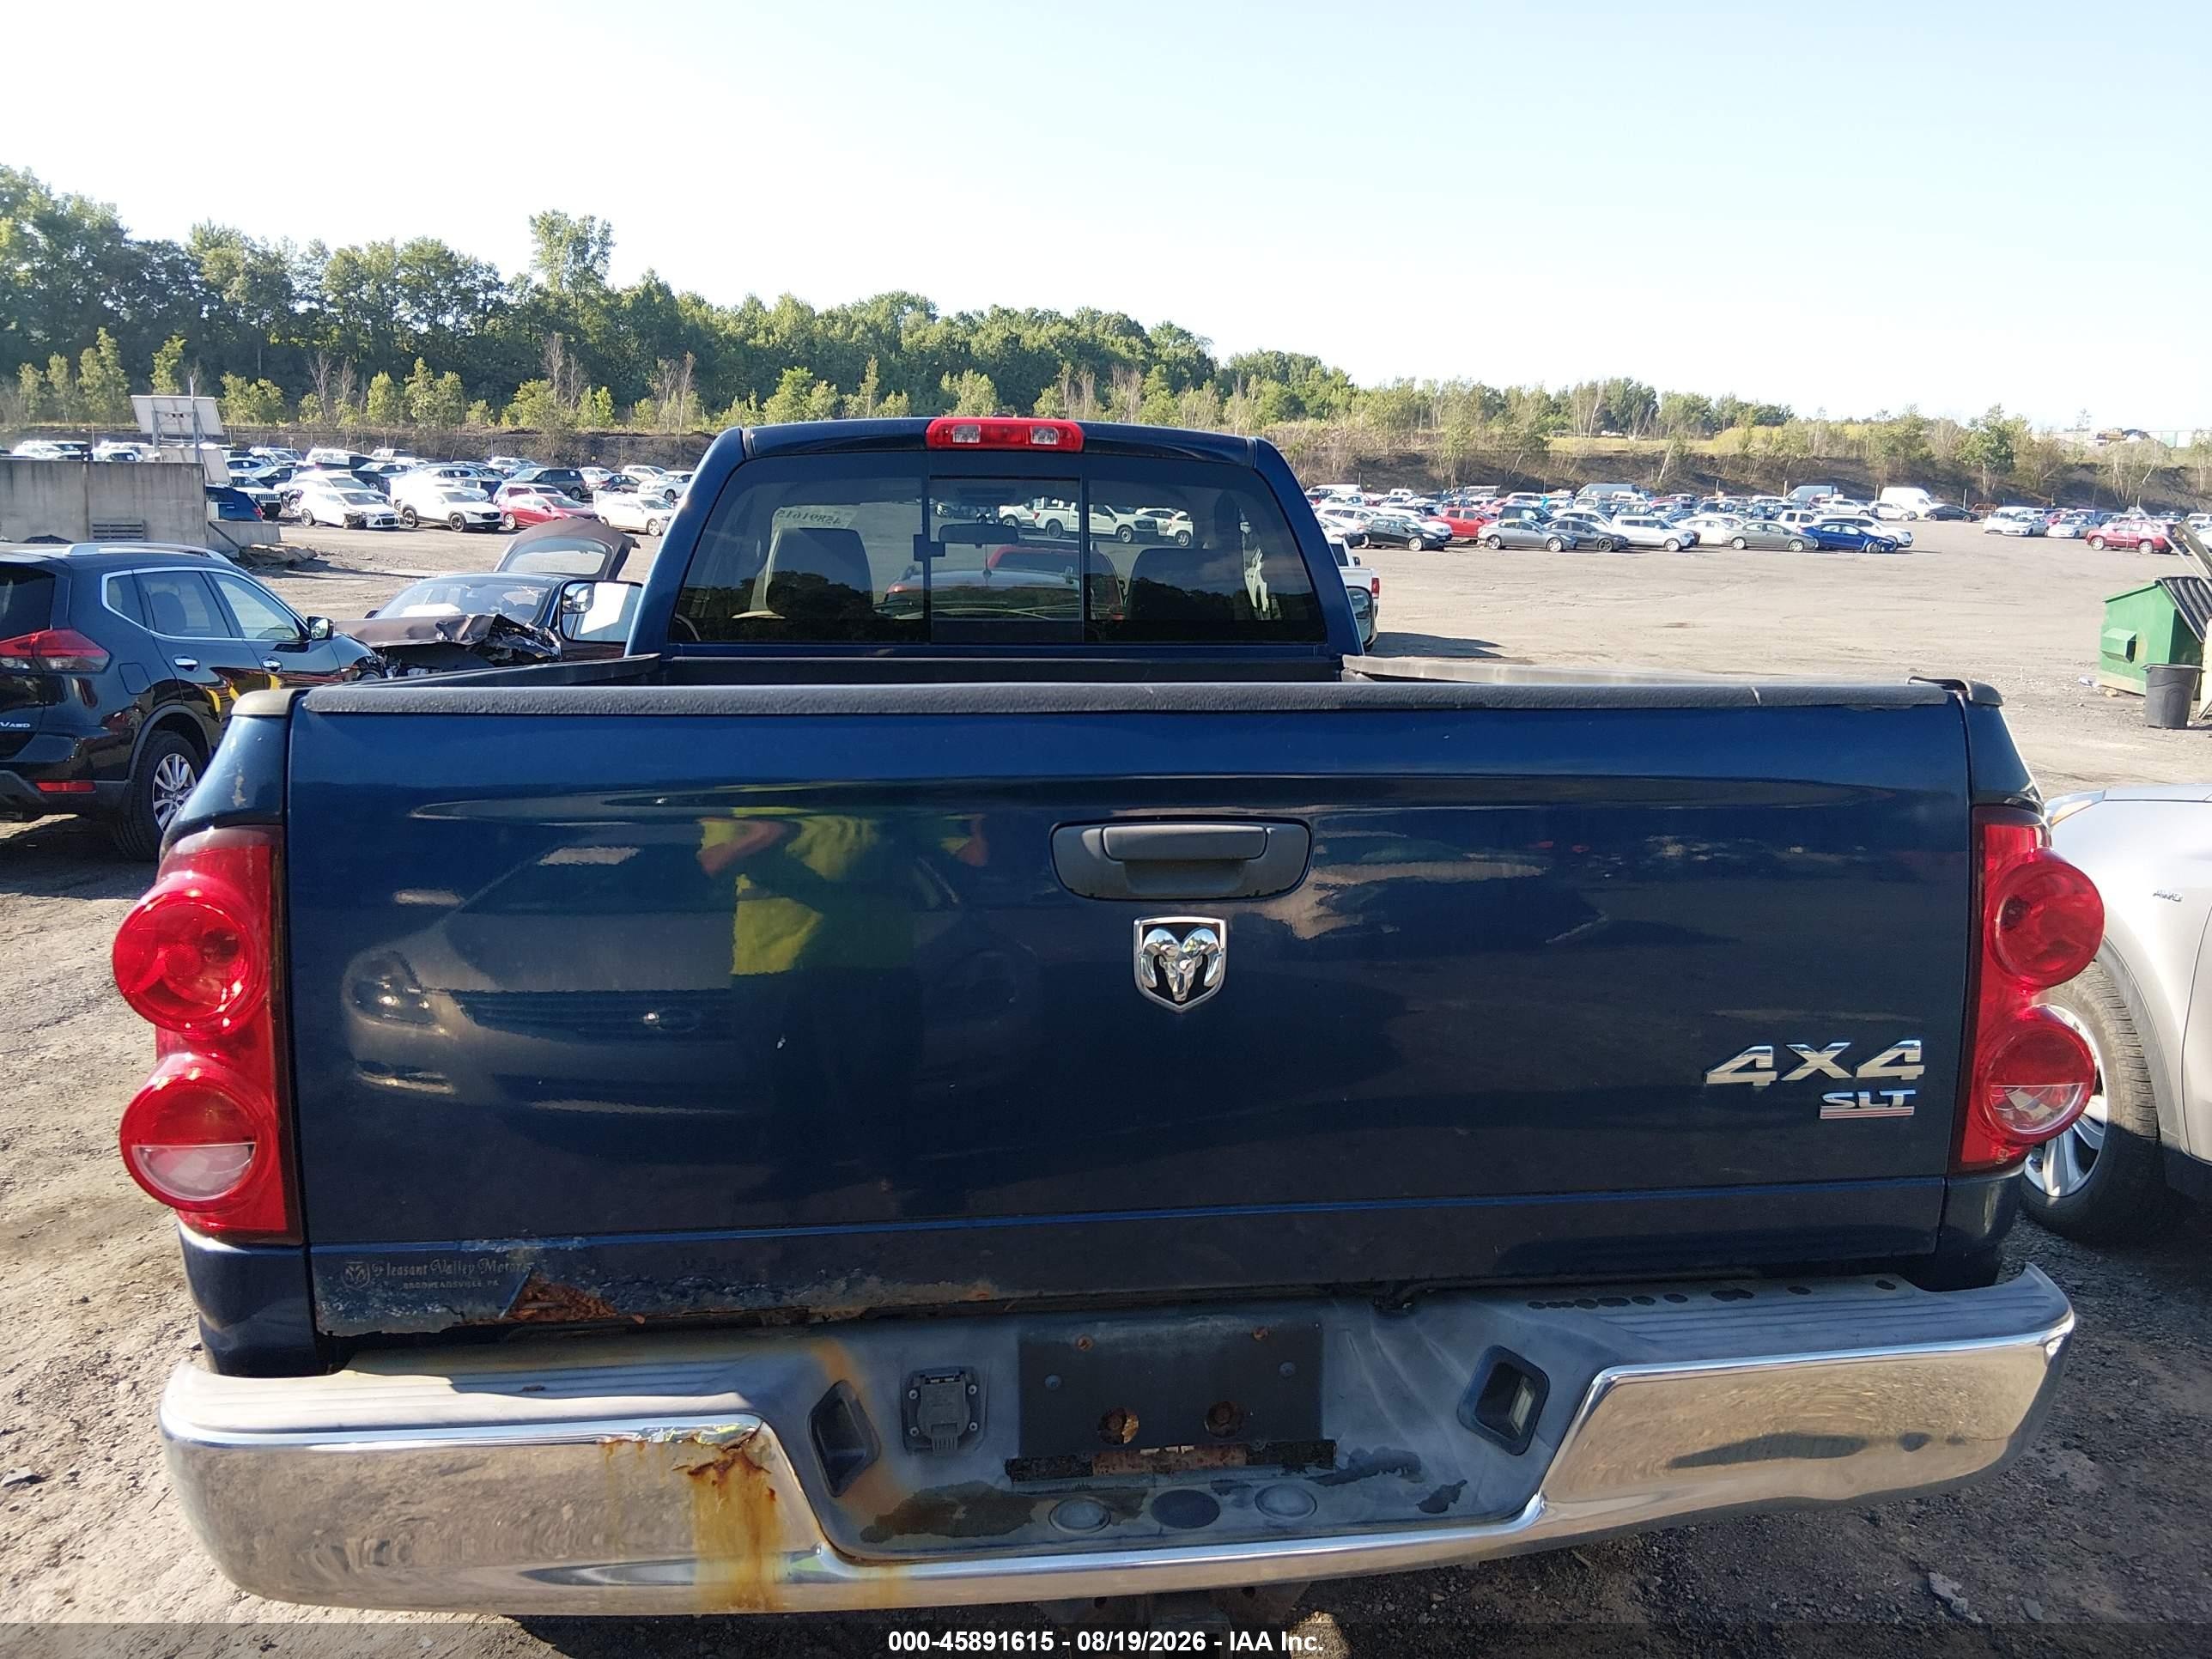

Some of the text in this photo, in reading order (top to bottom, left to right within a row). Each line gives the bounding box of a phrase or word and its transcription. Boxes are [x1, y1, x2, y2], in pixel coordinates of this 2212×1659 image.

[1821, 1090, 1916, 1109] SLT
[371, 1257, 532, 1278] Pleasant Valley Motors
